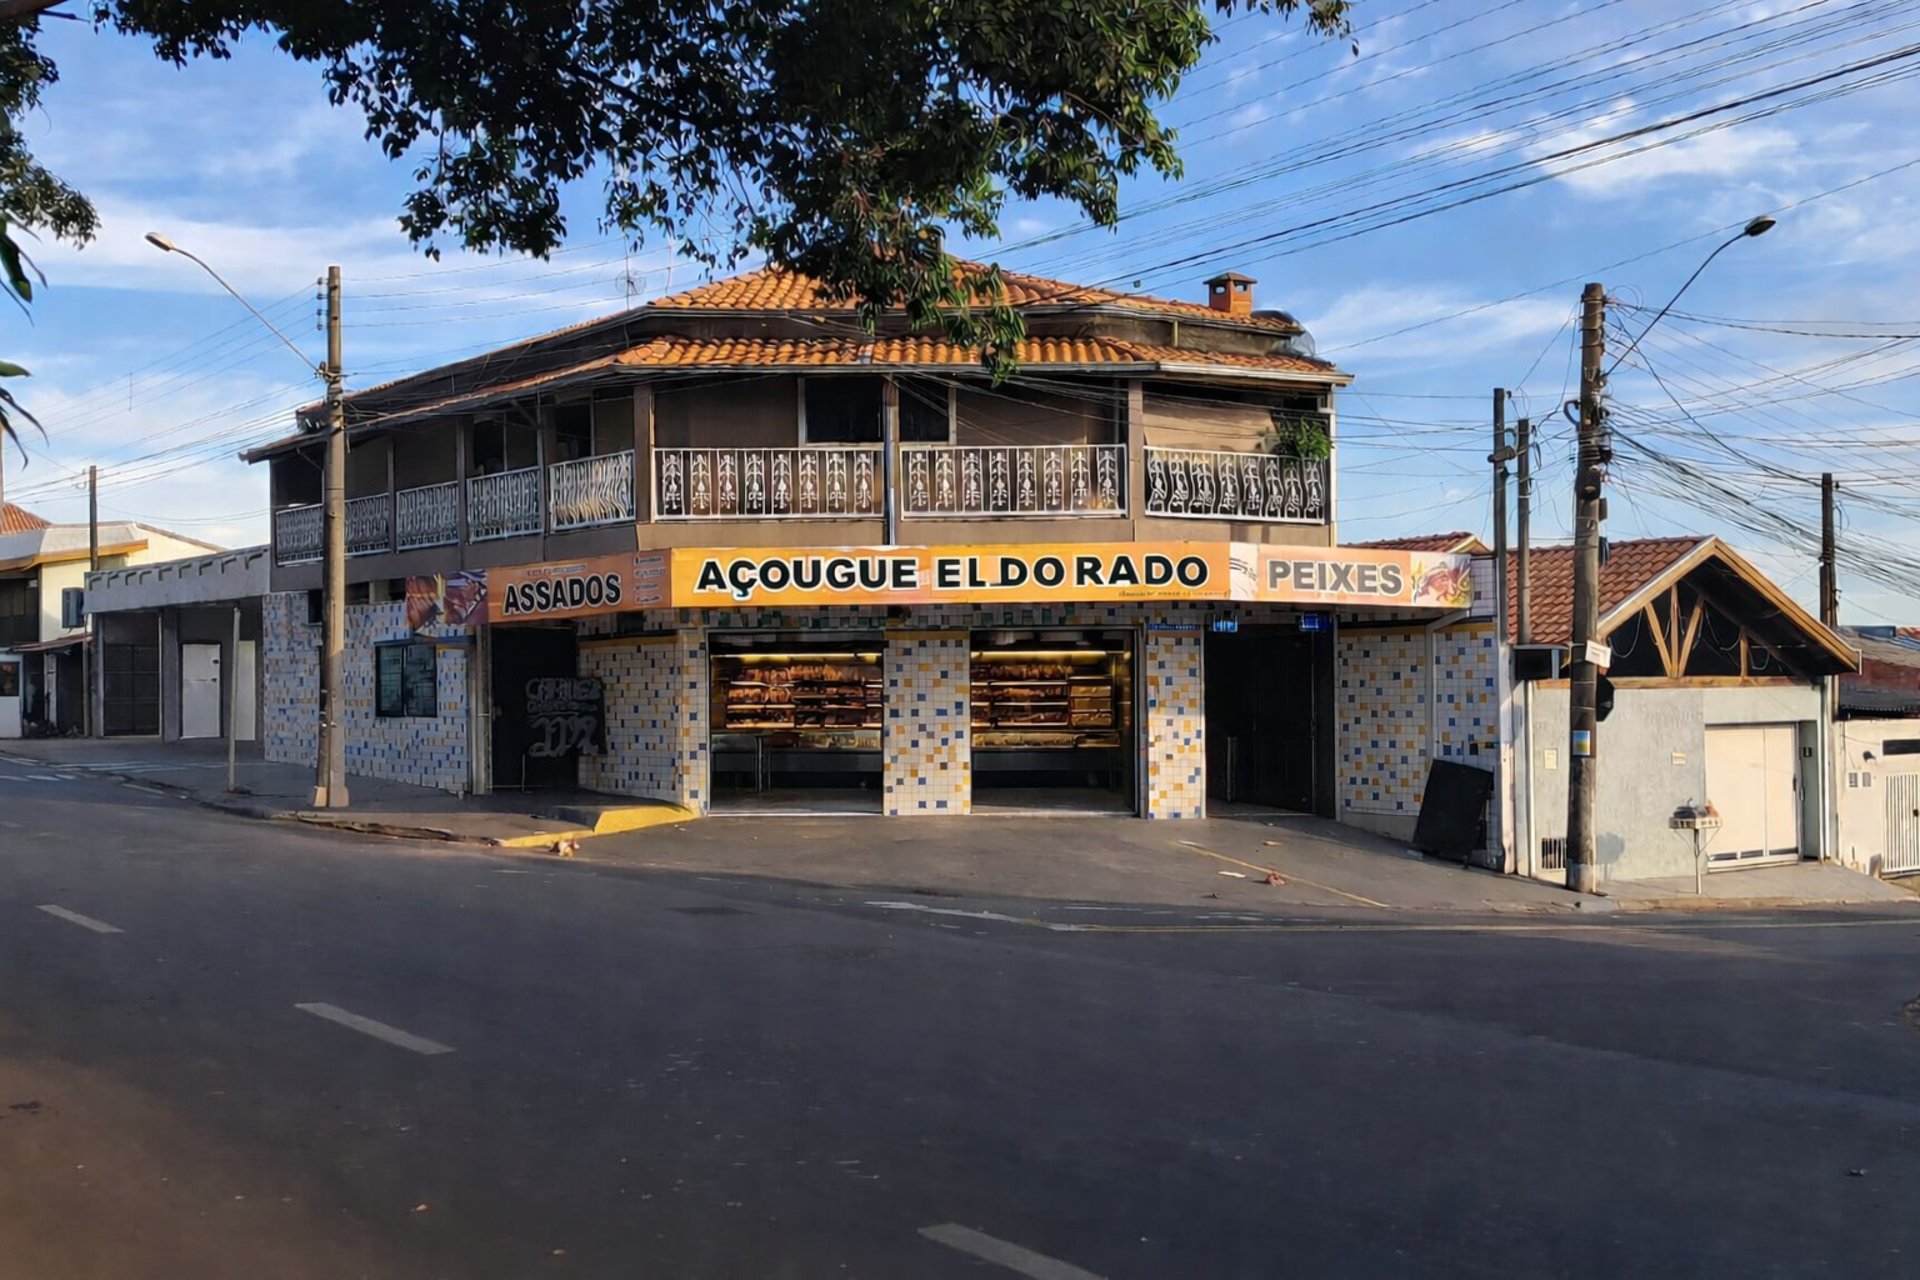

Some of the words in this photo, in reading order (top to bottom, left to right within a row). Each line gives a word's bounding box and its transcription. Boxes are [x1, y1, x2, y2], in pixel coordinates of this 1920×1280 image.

[503, 573, 623, 615] ASSADOS
[696, 558, 918, 599] AÇOUGUE
[1268, 560, 1402, 595] PEIXES
